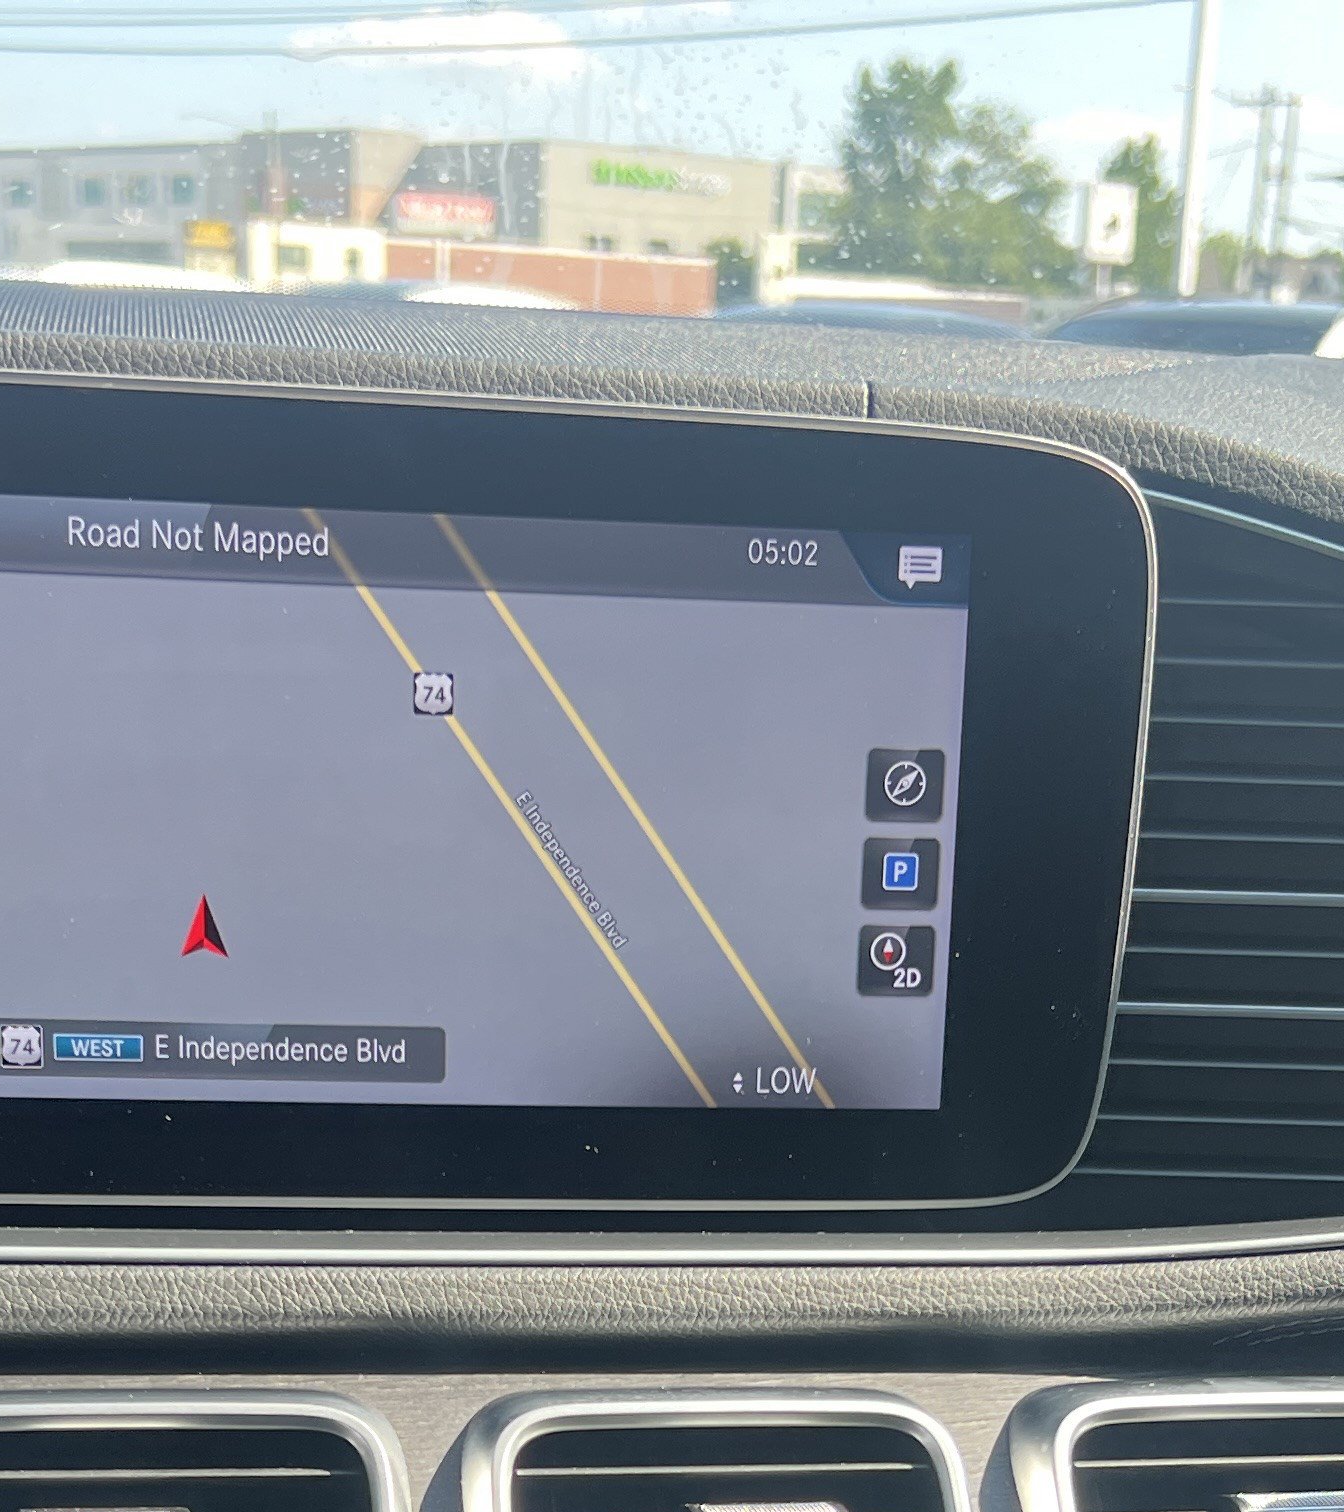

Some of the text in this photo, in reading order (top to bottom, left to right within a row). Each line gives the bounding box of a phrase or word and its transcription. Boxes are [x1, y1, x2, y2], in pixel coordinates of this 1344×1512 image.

[67, 515, 330, 563] Road Not Mapped
[748, 538, 818, 566] 05:02
[423, 685, 447, 703] 74
[515, 791, 628, 949] E Independence Blvd
[892, 967, 922, 989] 2D
[9, 1034, 407, 1067] 74 WEST E Independence Blvd
[756, 1065, 816, 1095] LOW
